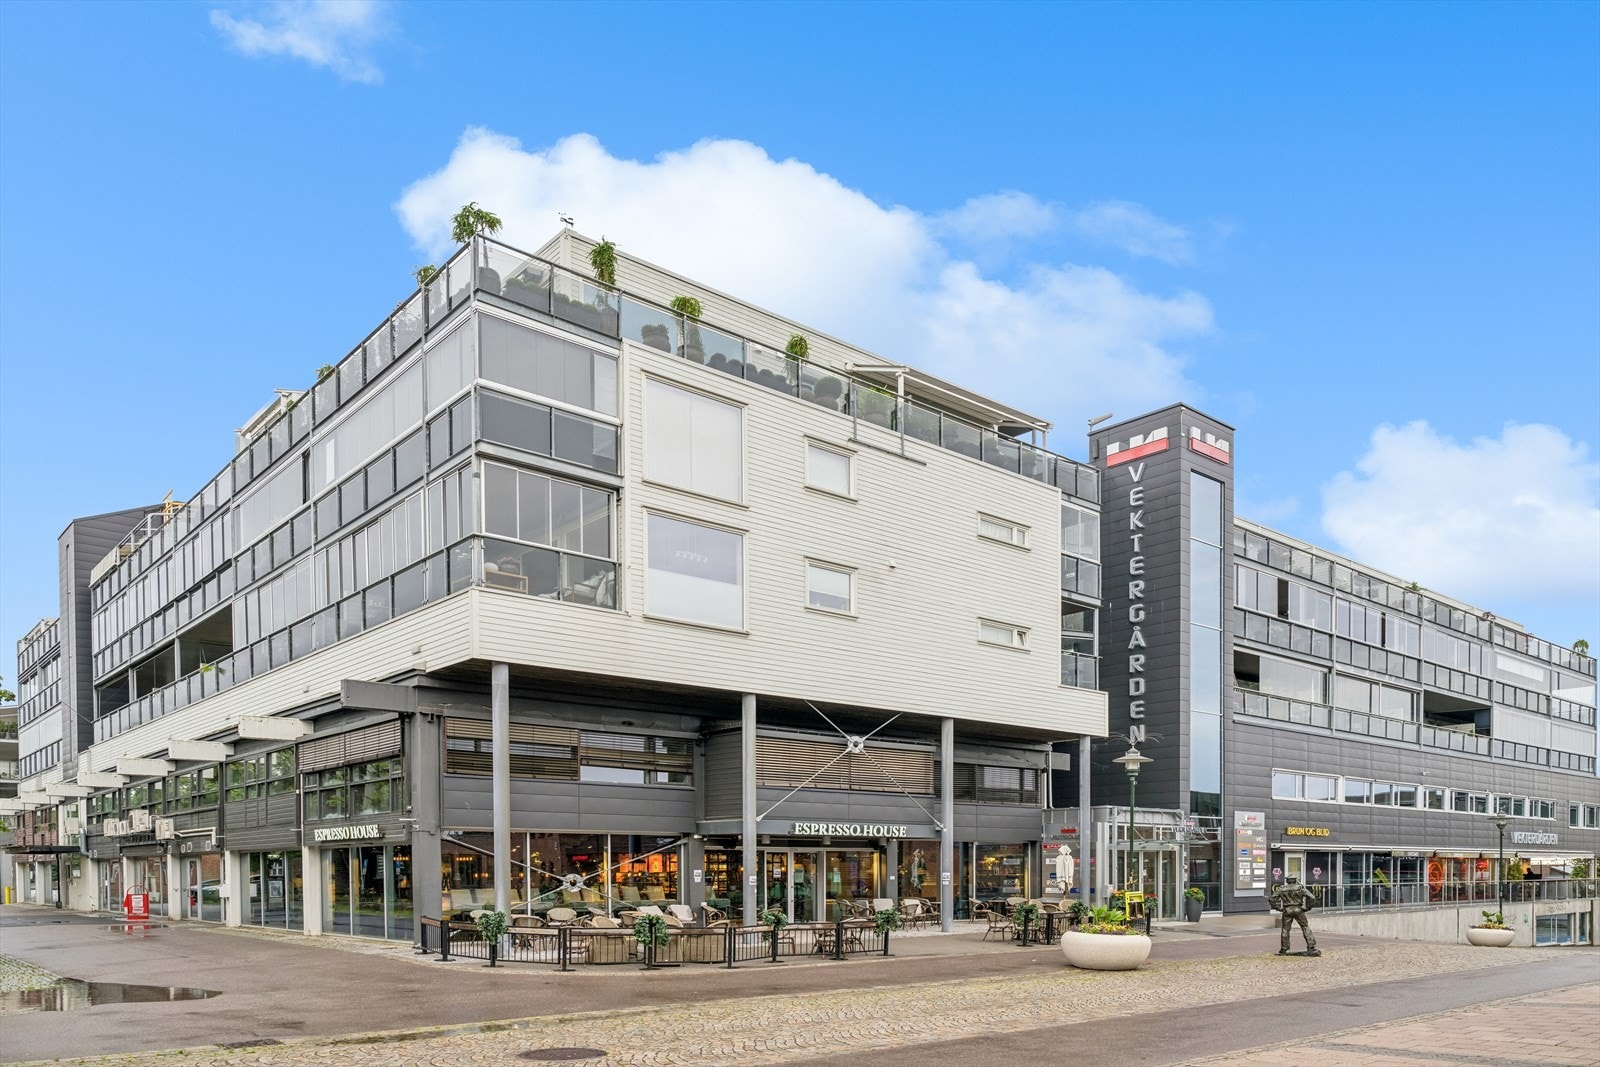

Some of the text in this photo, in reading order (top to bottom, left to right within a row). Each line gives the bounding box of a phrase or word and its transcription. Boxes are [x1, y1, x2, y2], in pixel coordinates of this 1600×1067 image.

[1128, 462, 1146, 743] VEKTERGÅRDEN
[314, 824, 380, 841] ESPRESSO HOUSE
[794, 822, 907, 838] ESPRESSO HOUSE
[1287, 826, 1305, 836] BRUN
[1305, 827, 1316, 836] OG
